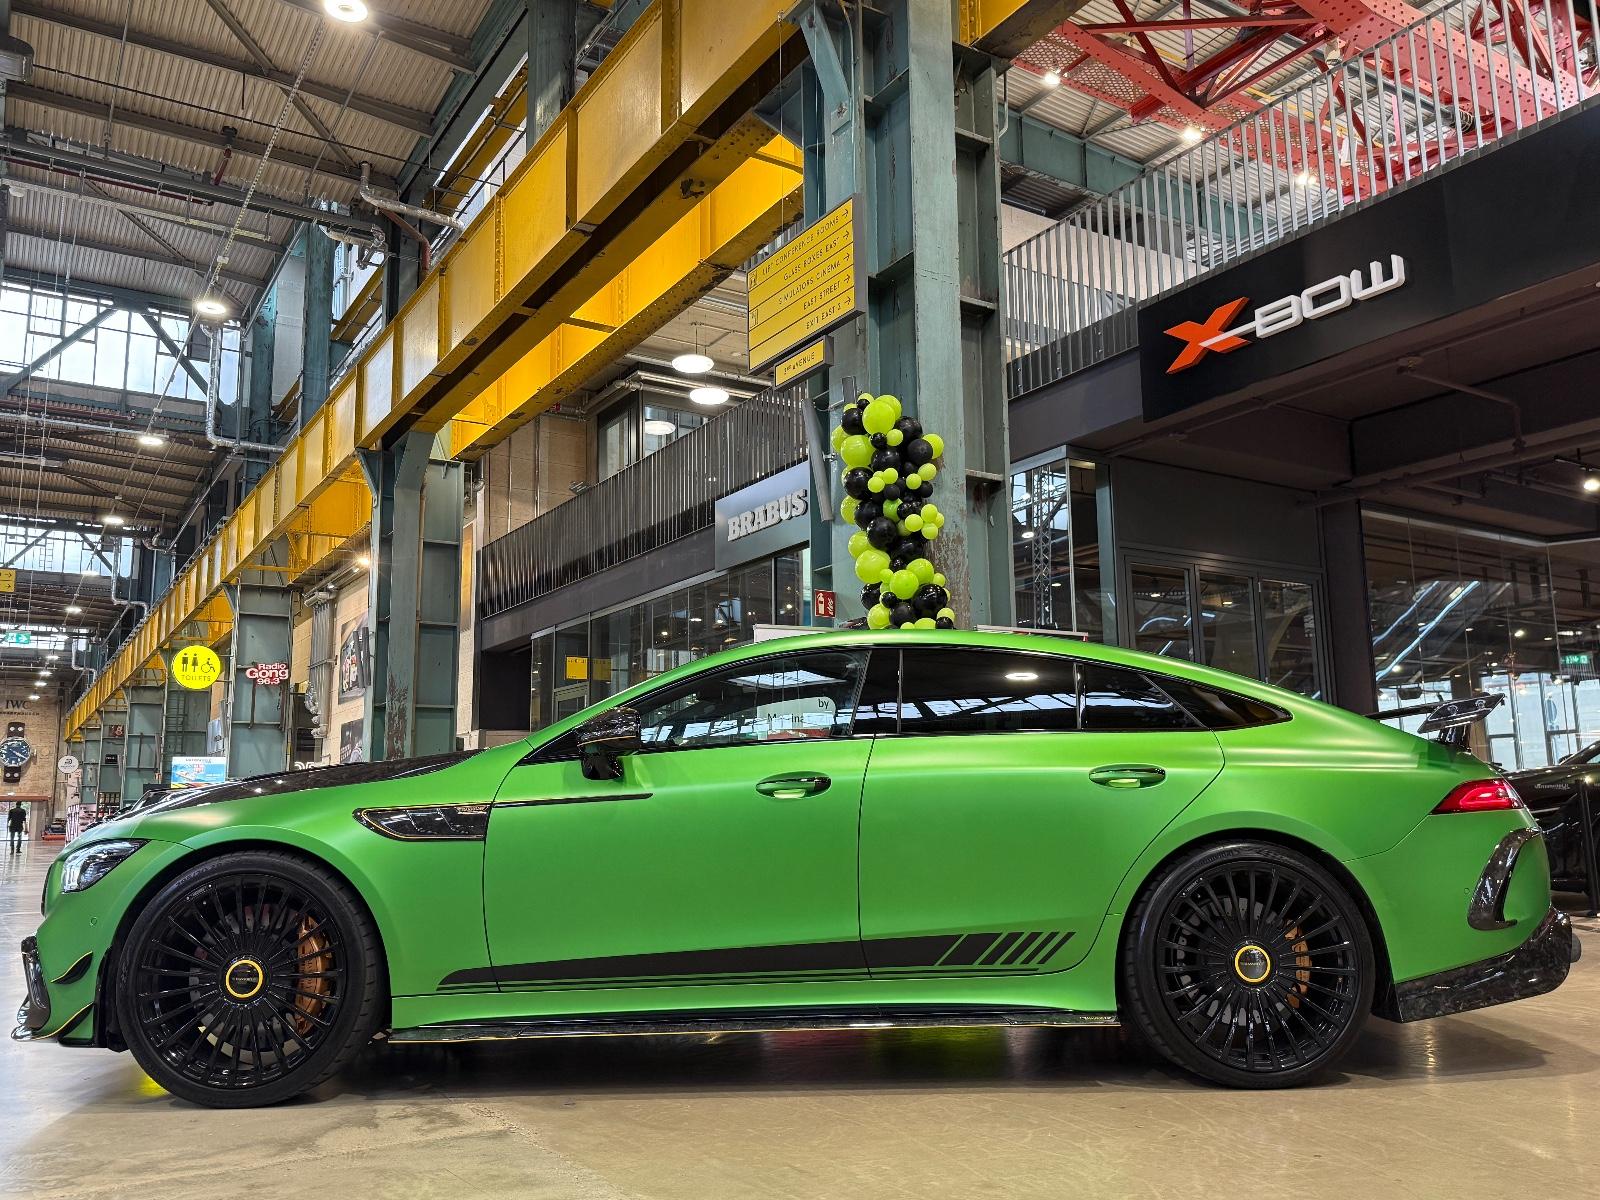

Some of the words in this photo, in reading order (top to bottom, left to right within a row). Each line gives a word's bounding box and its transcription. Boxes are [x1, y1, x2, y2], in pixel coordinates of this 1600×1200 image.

[775, 233, 814, 266] CONFERENCE
[816, 216, 839, 237] ROOMS
[783, 264, 801, 280] GLASS
[803, 248, 823, 268] BOXES
[825, 236, 840, 252] EAST
[778, 277, 814, 304] SIMULATORS
[816, 260, 841, 280] CINEMA
[803, 295, 817, 310] EAST
[820, 281, 840, 299] STREET
[806, 316, 819, 329] EXIT
[821, 306, 836, 320] EAST
[1163, 254, 1406, 375] X-BOW
[792, 351, 815, 370] AVENUE
[727, 488, 808, 541] BRABUS
[245, 667, 289, 680] Gong
[258, 662, 287, 670] Radio
[180, 674, 211, 682] TOILETS
[256, 677, 281, 685] 96.3
[6, 699, 33, 710] IWC
[818, 698, 830, 709] by
